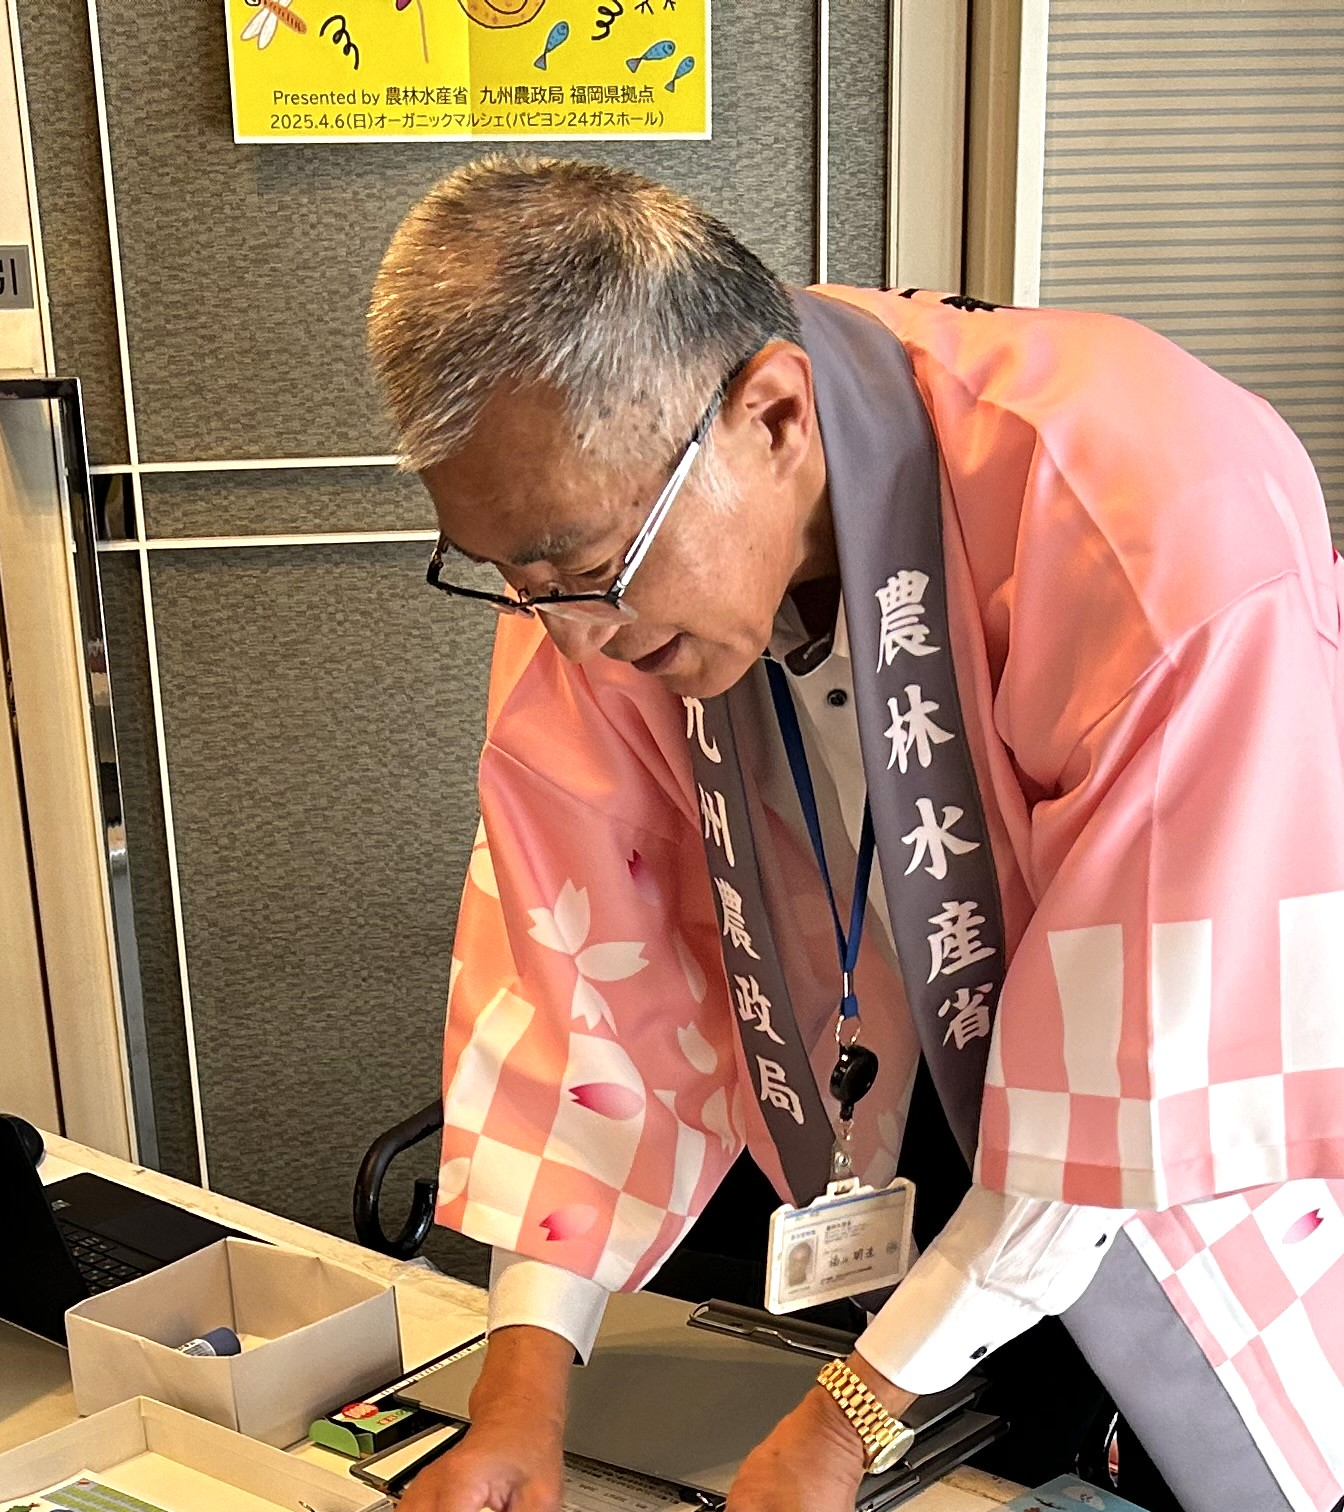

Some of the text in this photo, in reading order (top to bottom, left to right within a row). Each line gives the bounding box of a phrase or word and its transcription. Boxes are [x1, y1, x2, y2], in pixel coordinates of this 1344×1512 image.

[270, 111, 664, 131] 2025.4.6(日)オーガニックマルシェ(パピヨン24ガスホール)
[273, 86, 654, 108] Presented by 農林水産省 九州農政局 福岡県拠点
[684, 692, 805, 1126] 九州農政局
[875, 570, 998, 1050] 農林水産省
